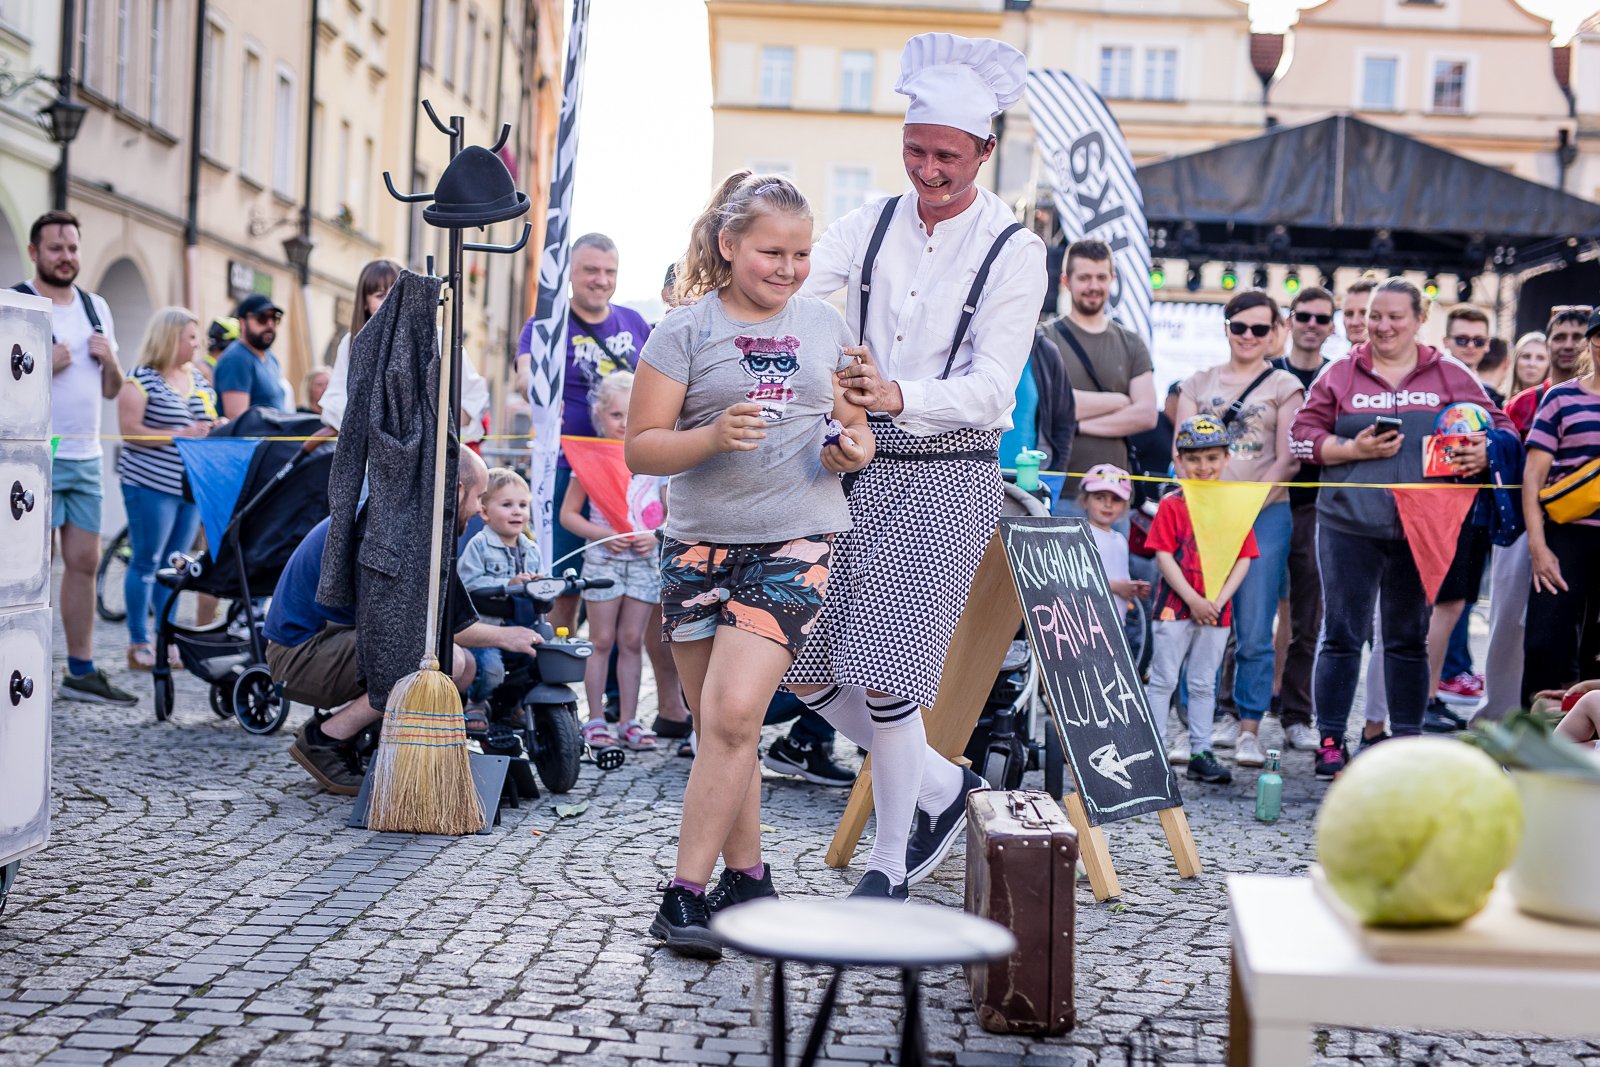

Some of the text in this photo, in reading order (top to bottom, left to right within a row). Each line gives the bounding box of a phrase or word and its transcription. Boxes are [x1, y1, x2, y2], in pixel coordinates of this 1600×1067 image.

[1352, 390, 1440, 409] adidas
[1011, 539, 1104, 597] KUCHNIA
[1032, 592, 1114, 661] PANA
[1054, 660, 1147, 729] LULKA
